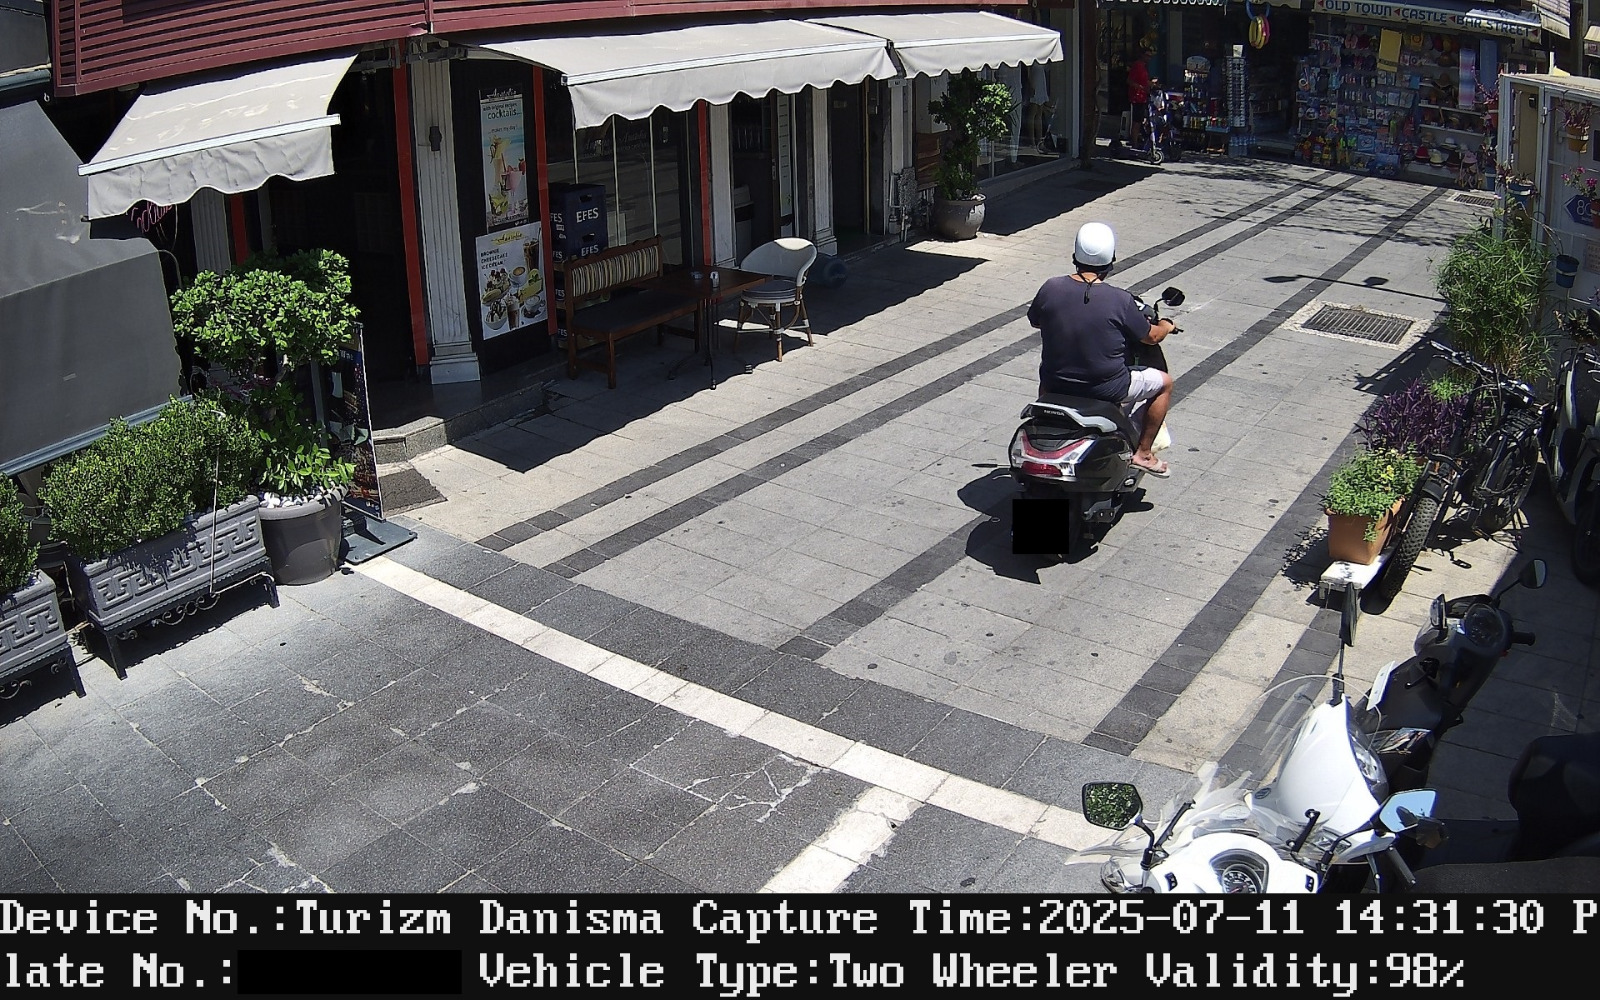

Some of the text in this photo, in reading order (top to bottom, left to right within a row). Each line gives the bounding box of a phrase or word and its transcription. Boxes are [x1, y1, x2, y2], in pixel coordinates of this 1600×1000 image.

[1325, 0, 1351, 12] OLD
[1401, 8, 1448, 23] CASTLE
[1457, 15, 1481, 28] BAR
[1486, 20, 1529, 37] STREET
[550, 213, 563, 223] FES
[576, 207, 599, 223] EFES
[582, 245, 599, 257] EFES
[481, 252, 508, 264] CHEESECAKE
